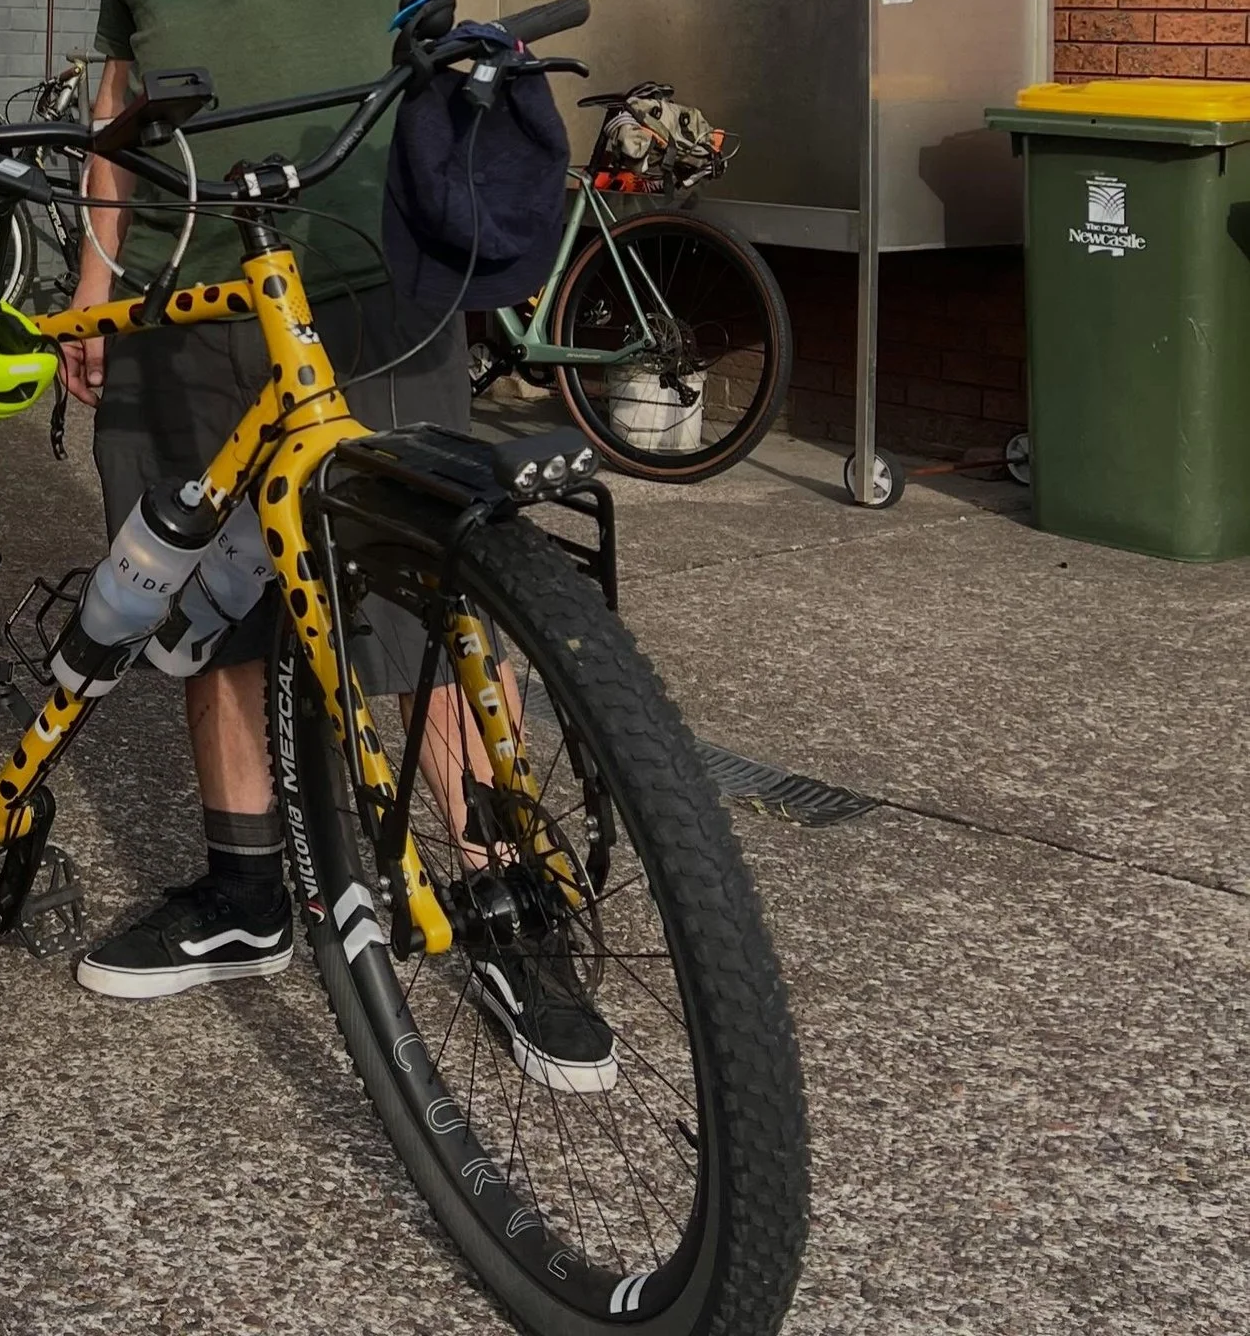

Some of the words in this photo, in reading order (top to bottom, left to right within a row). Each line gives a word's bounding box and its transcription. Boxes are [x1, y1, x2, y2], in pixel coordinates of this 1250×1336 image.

[1069, 228, 1146, 250] Newcastle
[1085, 222, 1101, 231] The
[1101, 224, 1119, 234] City
[1119, 226, 1130, 234] of
[218, 533, 238, 561] EK
[119, 557, 172, 594] RIDE
[278, 657, 299, 794] MEZCAL
